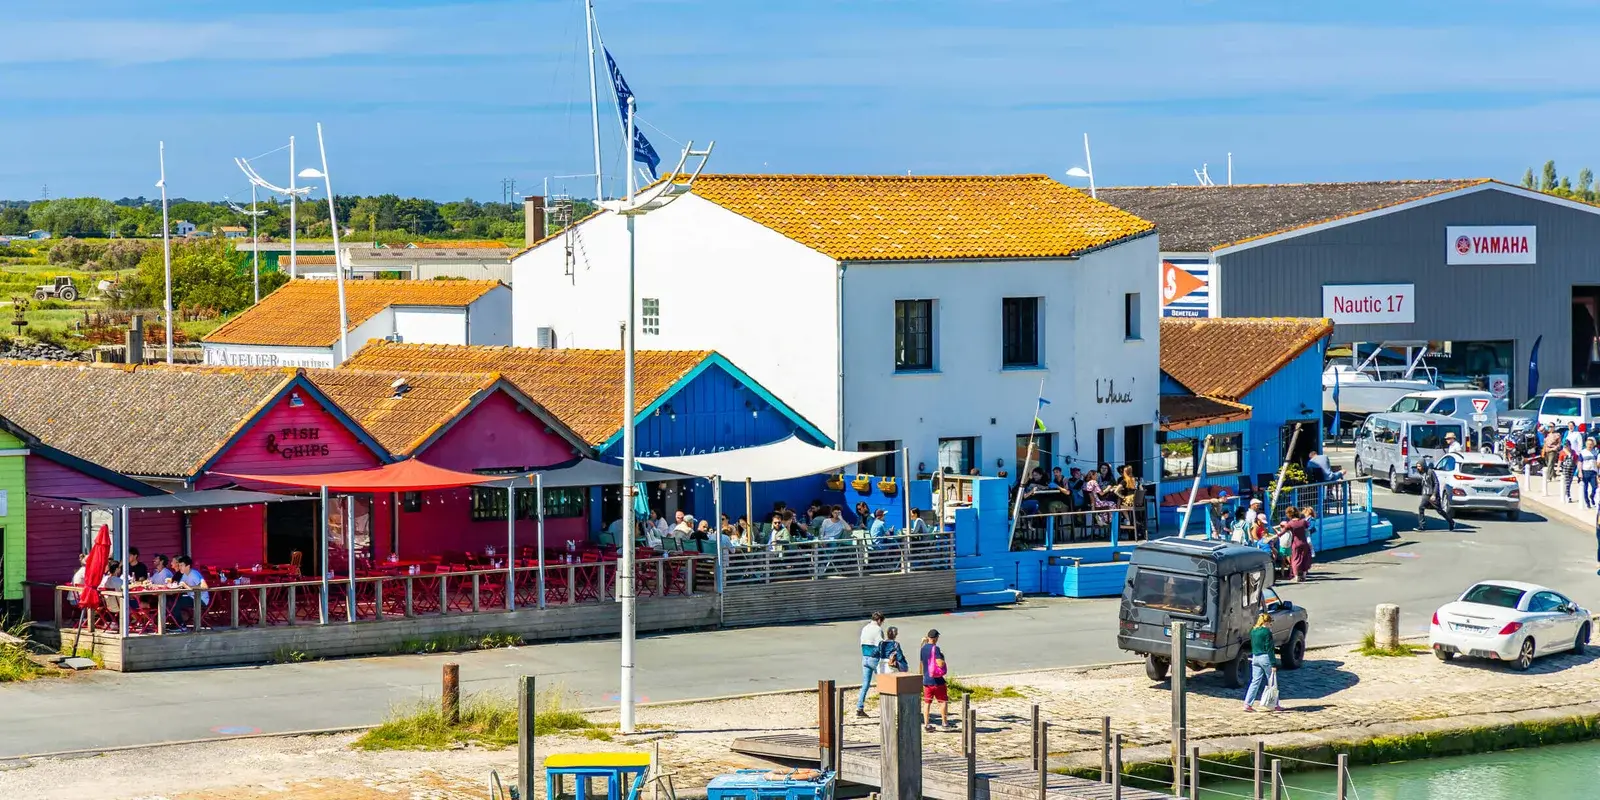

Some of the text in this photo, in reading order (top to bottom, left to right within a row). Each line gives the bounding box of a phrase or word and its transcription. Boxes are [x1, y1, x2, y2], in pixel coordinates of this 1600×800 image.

[1473, 236, 1528, 254] YAMAHA
[1171, 309, 1199, 317] BENETEAU
[1334, 295, 1404, 313] Nautic 17
[205, 348, 280, 367] L'ATELIER
[281, 427, 320, 440] FISH
[266, 433, 330, 460] & CHIPS
